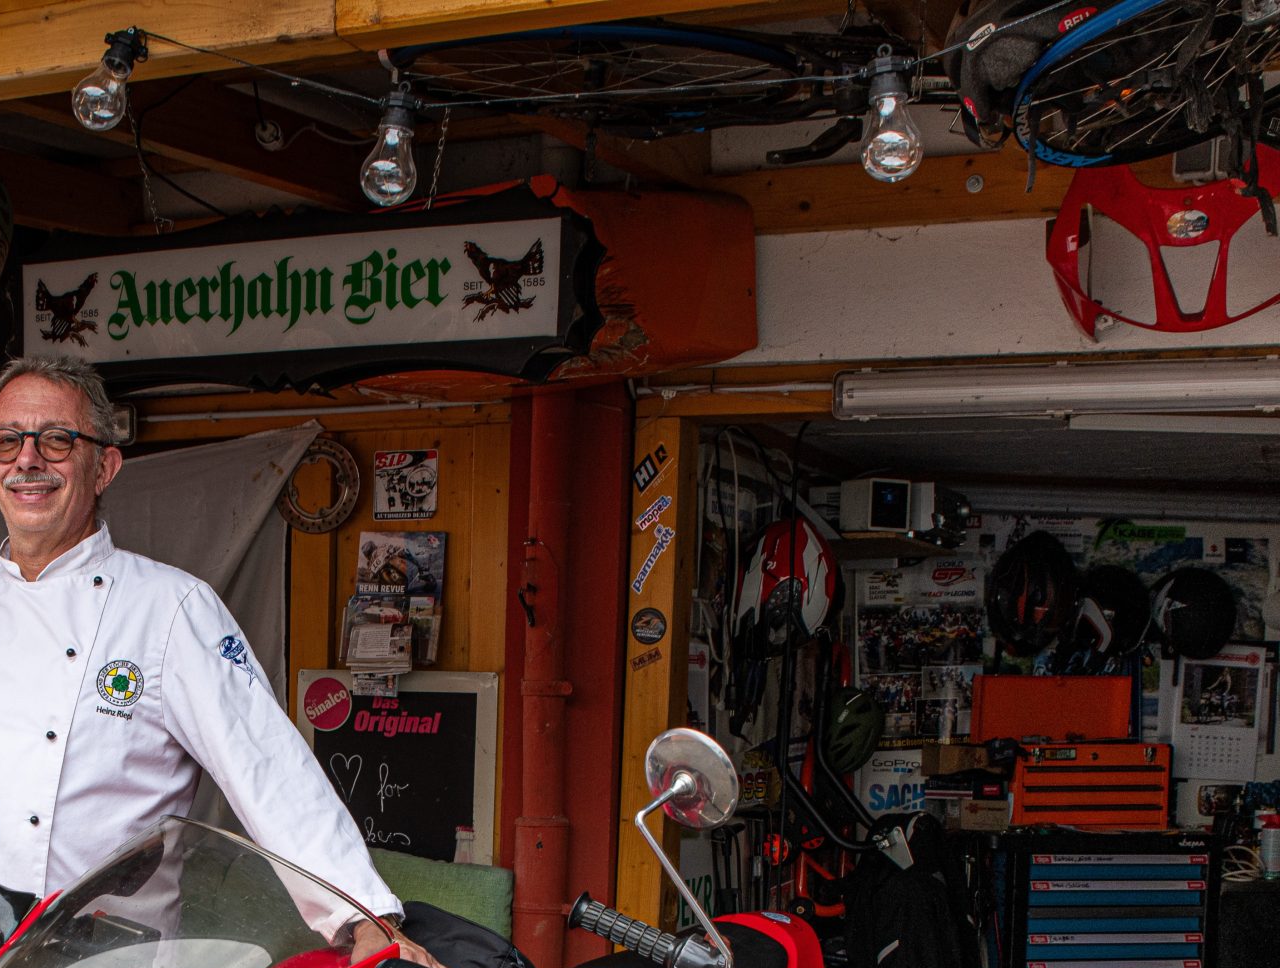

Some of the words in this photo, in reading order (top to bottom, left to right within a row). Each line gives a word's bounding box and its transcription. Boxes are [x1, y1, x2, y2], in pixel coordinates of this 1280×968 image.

[463, 280, 483, 291] SEIT
[522, 276, 546, 288] 1585
[106, 255, 333, 342] Auerhahn
[344, 247, 452, 325] Bier
[34, 313, 52, 323] SEIT
[80, 308, 100, 319] 1585
[640, 498, 670, 529] moped
[359, 584, 379, 593] RENN
[380, 584, 406, 593] REVUE
[96, 705, 117, 717] Heinz
[305, 688, 348, 720] Sinalco
[371, 695, 401, 710] Das
[353, 710, 443, 738] Original
[871, 758, 921, 768] GoPro
[377, 762, 410, 813] for
[677, 873, 714, 929] EKR
